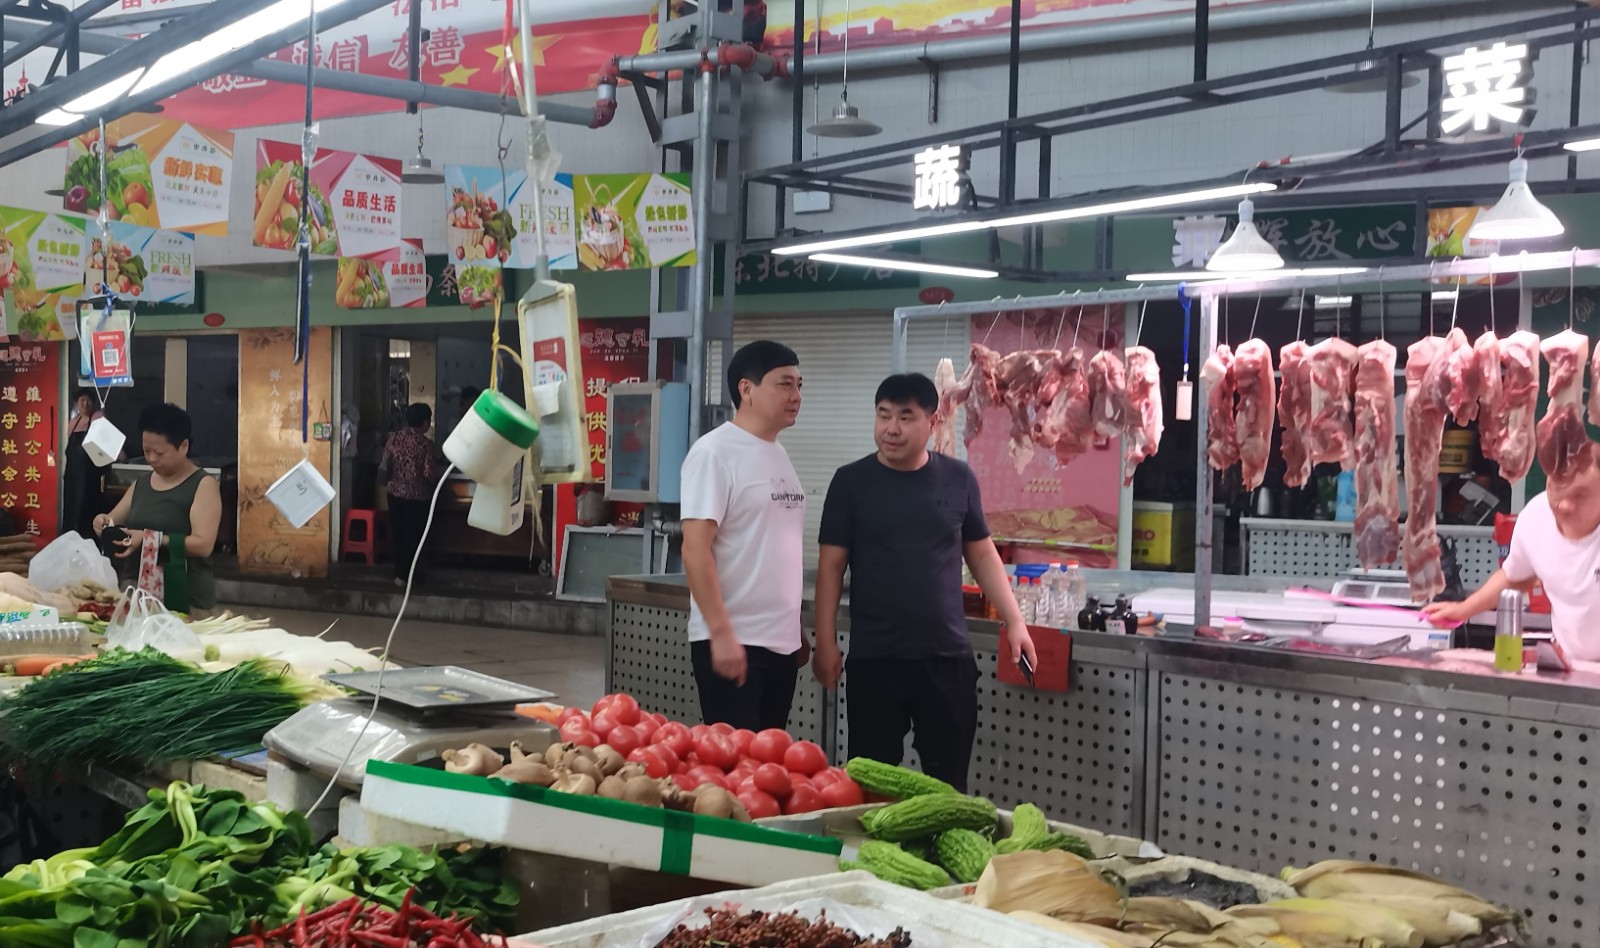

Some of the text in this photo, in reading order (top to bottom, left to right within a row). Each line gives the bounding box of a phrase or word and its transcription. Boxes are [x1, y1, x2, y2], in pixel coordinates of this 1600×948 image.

[913, 42, 1528, 209] 蔬 菜
[342, 189, 396, 213] 品质生活
[519, 203, 570, 221] FRSH
[391, 263, 424, 276] 品质生活
[1, 387, 18, 508] 遵守社会公
[25, 386, 42, 536] 维护公共卫生
[584, 377, 607, 484] 提供优
